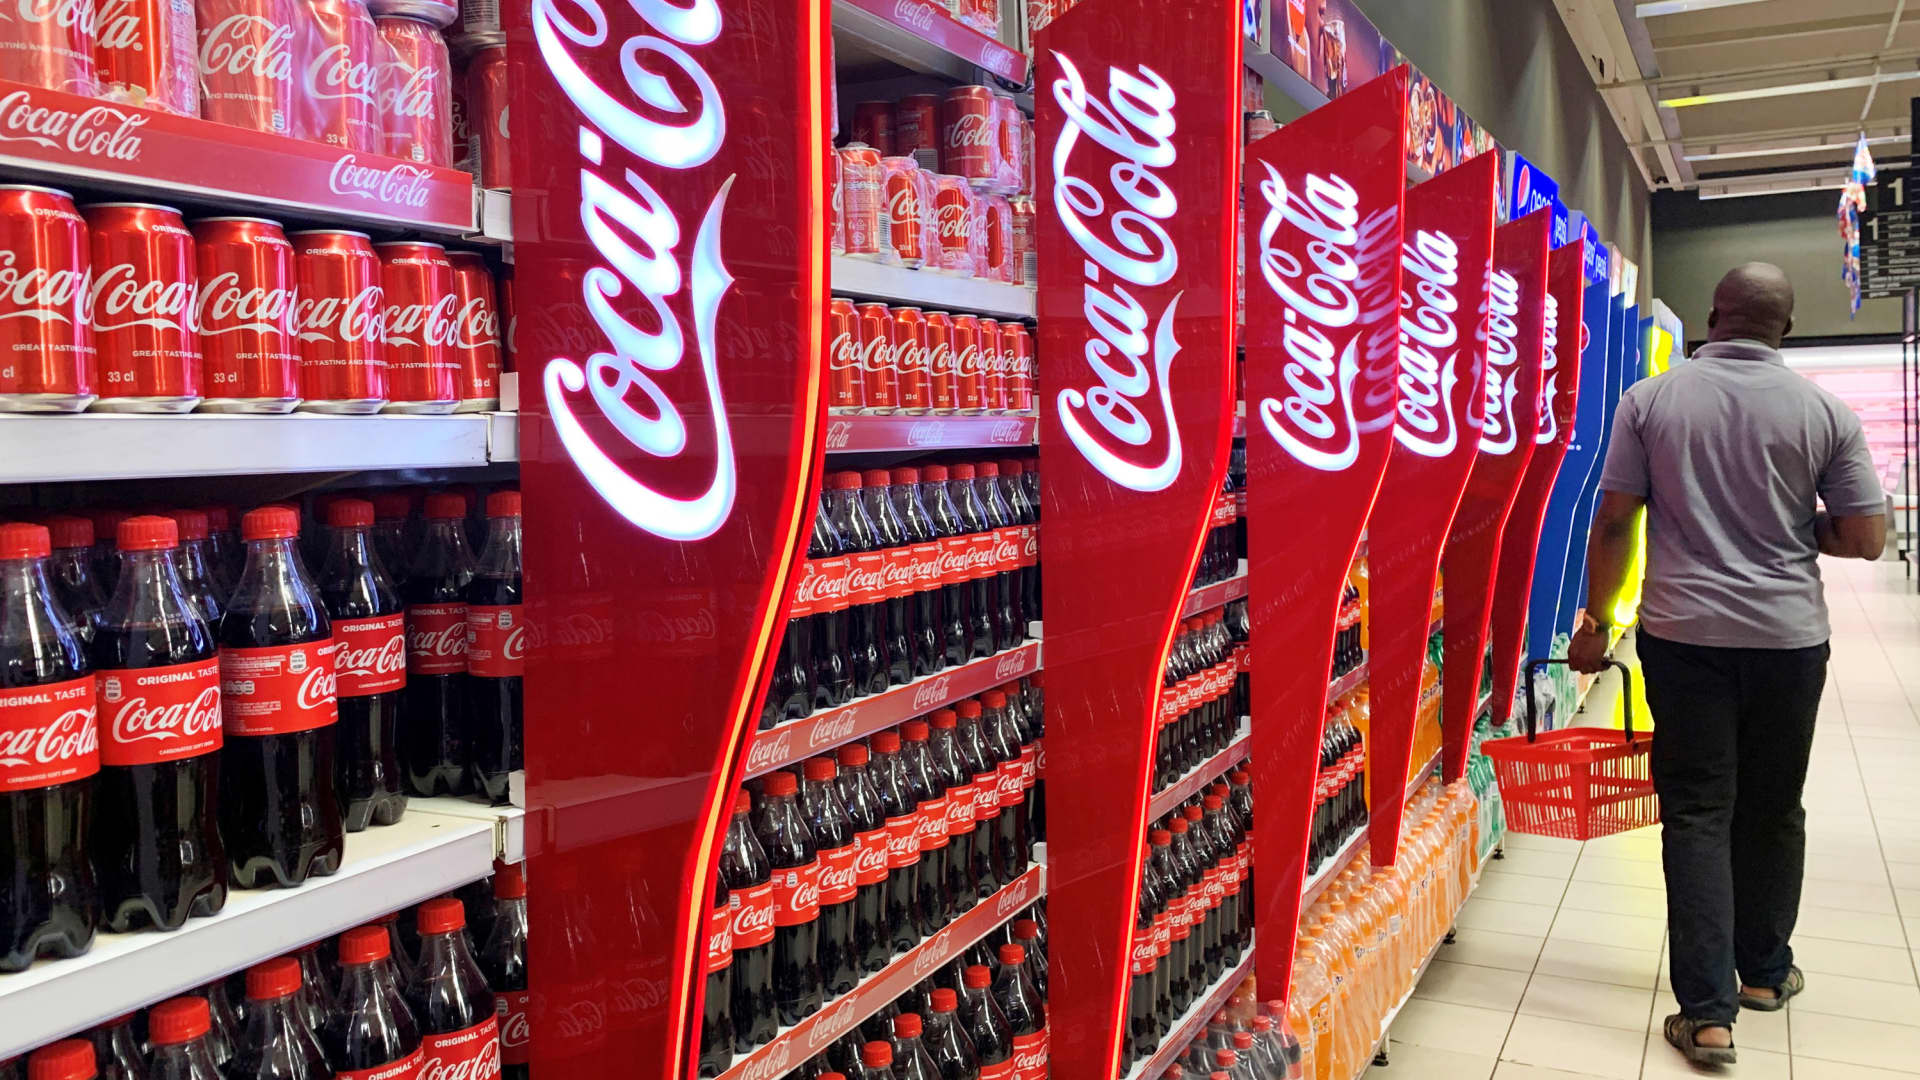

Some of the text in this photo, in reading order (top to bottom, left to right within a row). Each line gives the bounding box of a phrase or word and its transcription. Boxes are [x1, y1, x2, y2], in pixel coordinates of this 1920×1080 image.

[0, 91, 150, 160] Coca-Cola
[329, 154, 434, 207] Coca-Cola
[1887, 177, 1904, 206] 1
[1866, 217, 1879, 240] 1
[1048, 48, 1184, 492] Coca-Cola
[1258, 157, 1363, 472] Coca-Cola
[107, 370, 134, 383] 33 cl
[213, 371, 237, 383] 33 cl
[342, 622, 386, 633] ORIGINAL
[136, 671, 195, 686] ORIGINAL
[996, 648, 1027, 680] Coca-Cola
[54, 686, 86, 700] TASTE
[913, 674, 951, 710] Coca-Cola
[809, 706, 858, 747] Coca-Cola
[997, 877, 1028, 916] Coca-Cola
[913, 929, 951, 976] Coca-Cola
[809, 995, 857, 1048] Coca-Cola
[434, 1033, 478, 1048] ORIGINAL
